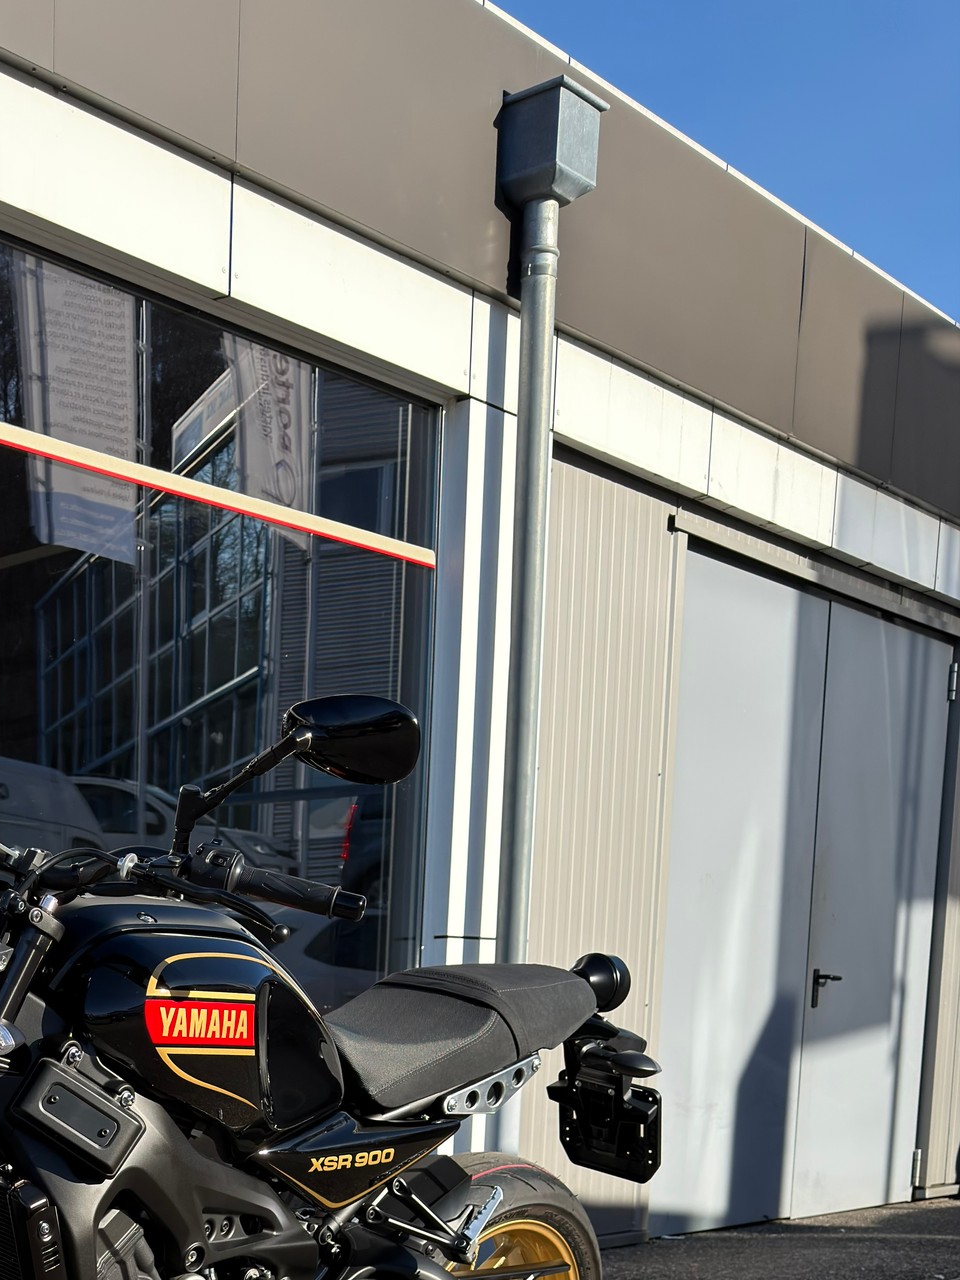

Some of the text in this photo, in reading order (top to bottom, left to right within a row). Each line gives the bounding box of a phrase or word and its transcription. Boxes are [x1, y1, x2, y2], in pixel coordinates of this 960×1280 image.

[160, 1007, 248, 1039] YAMAHA
[308, 1148, 395, 1172] XSR 900
